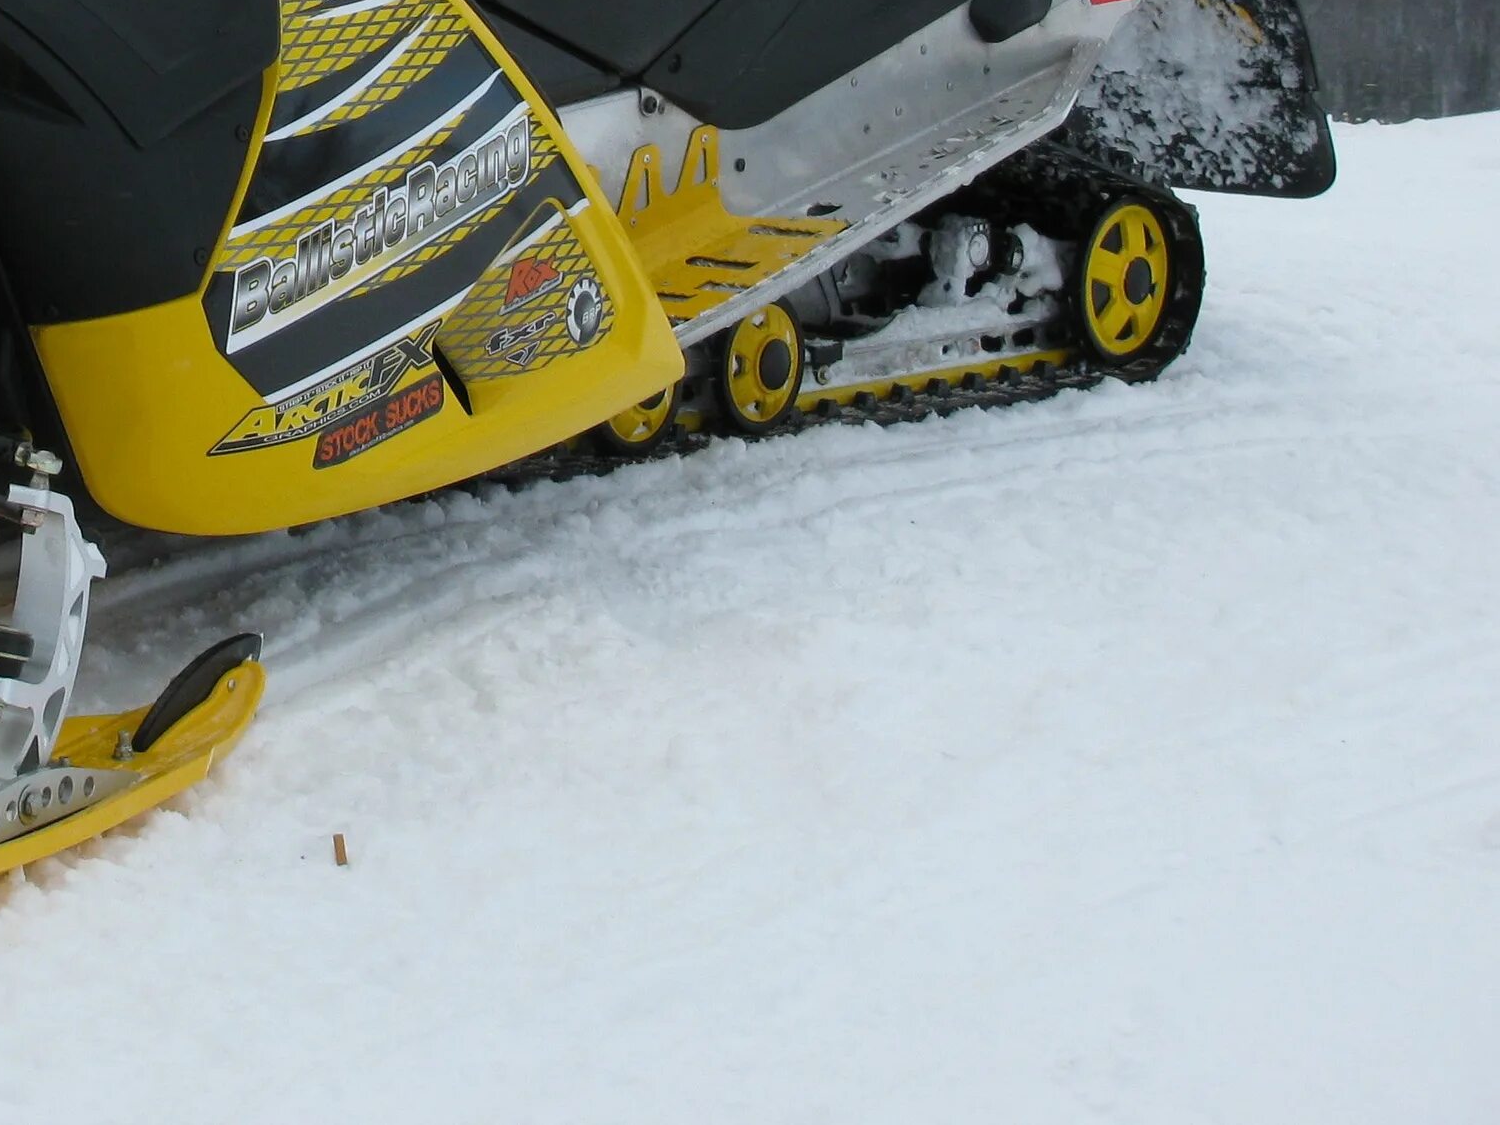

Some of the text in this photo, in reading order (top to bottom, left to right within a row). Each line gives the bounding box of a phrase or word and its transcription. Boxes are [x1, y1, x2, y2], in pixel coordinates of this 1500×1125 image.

[263, 388, 381, 443] GRAPHICS.COM
[320, 411, 379, 461] STOCK
[385, 379, 441, 429] SUCKS
